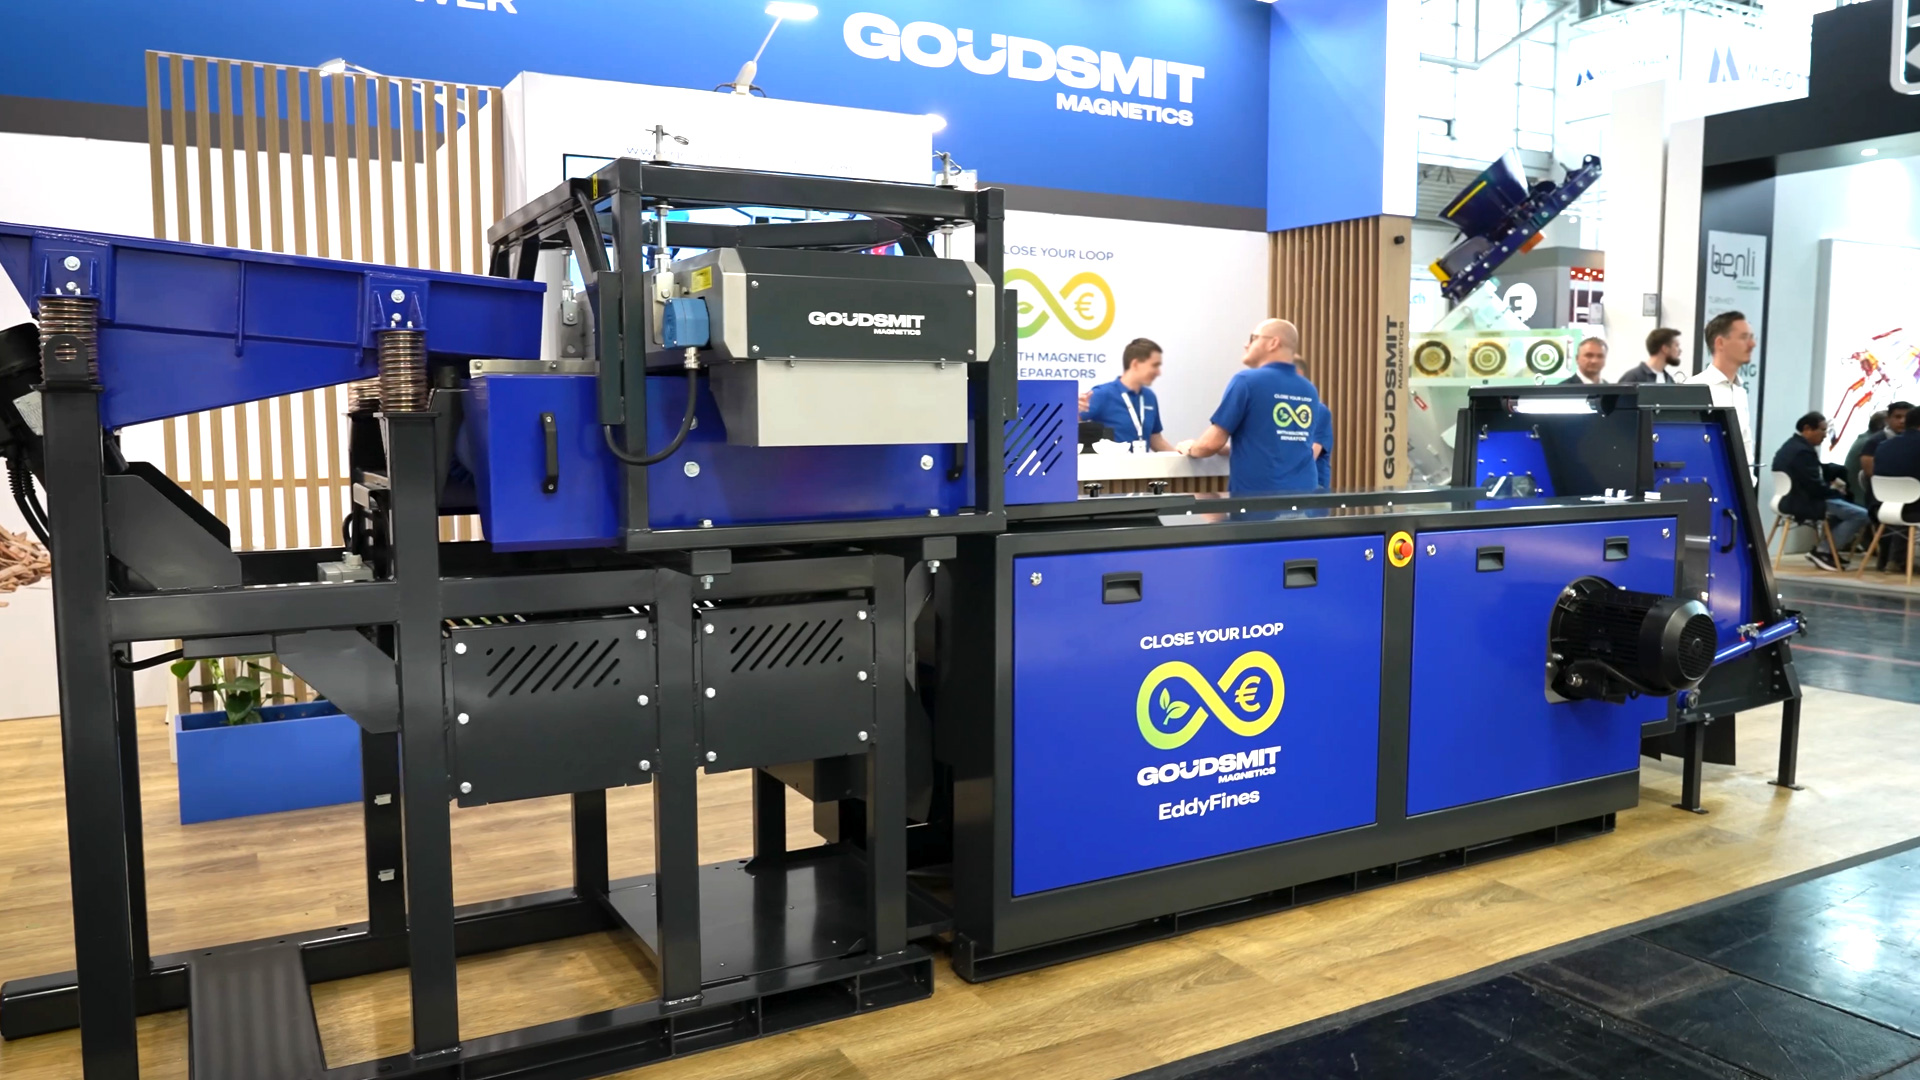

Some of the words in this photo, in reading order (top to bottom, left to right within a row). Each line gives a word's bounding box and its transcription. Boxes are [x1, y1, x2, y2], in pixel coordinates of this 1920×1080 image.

[843, 11, 1205, 104] GOUDSMIT
[1056, 92, 1194, 127] MAGNETICS
[1003, 245, 1037, 257] LOSE
[1040, 247, 1076, 258] YOUR
[1079, 250, 1114, 261] LOOP
[808, 311, 925, 328] GOUDSMIT
[873, 328, 921, 336] MAGNETICS
[1017, 351, 1035, 362] TH
[1038, 352, 1106, 363] MAGNETIC
[1018, 367, 1097, 379] EPARATORS
[1383, 315, 1398, 480] GOUDSMIT
[1140, 631, 1195, 650] CLOSE
[1196, 627, 1240, 644] YOUR
[1242, 622, 1284, 639] LOOP
[1136, 745, 1282, 787] GOUDSMIT
[1218, 766, 1276, 784] MAGNETICS
[1158, 790, 1260, 821] EddyFines
